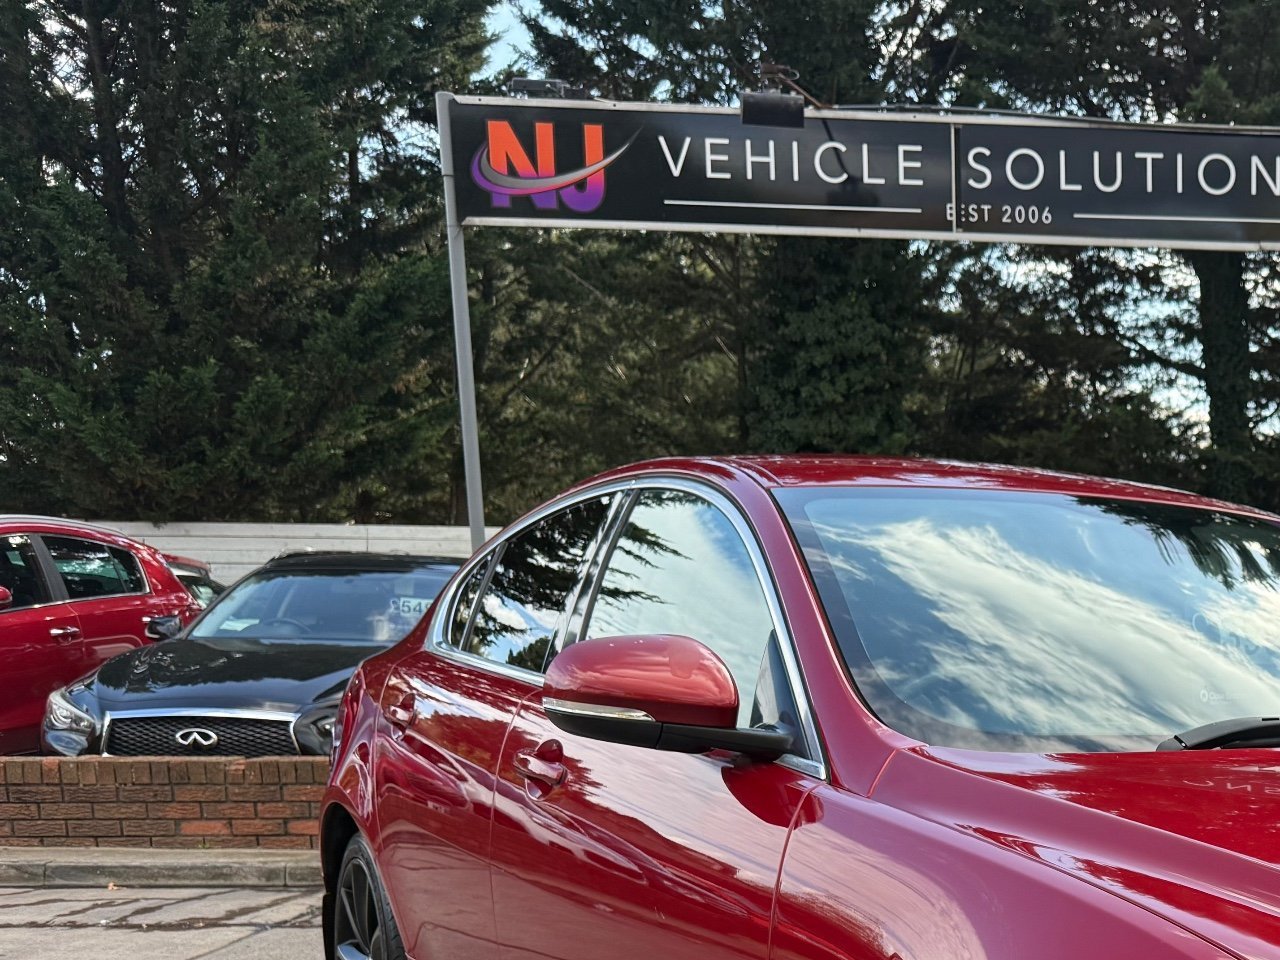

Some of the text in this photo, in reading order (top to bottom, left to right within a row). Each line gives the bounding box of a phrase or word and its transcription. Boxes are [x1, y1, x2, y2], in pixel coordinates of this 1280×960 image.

[485, 120, 607, 213] NJ
[657, 135, 924, 187] VEHICLE
[946, 203, 1053, 225] EST 2006
